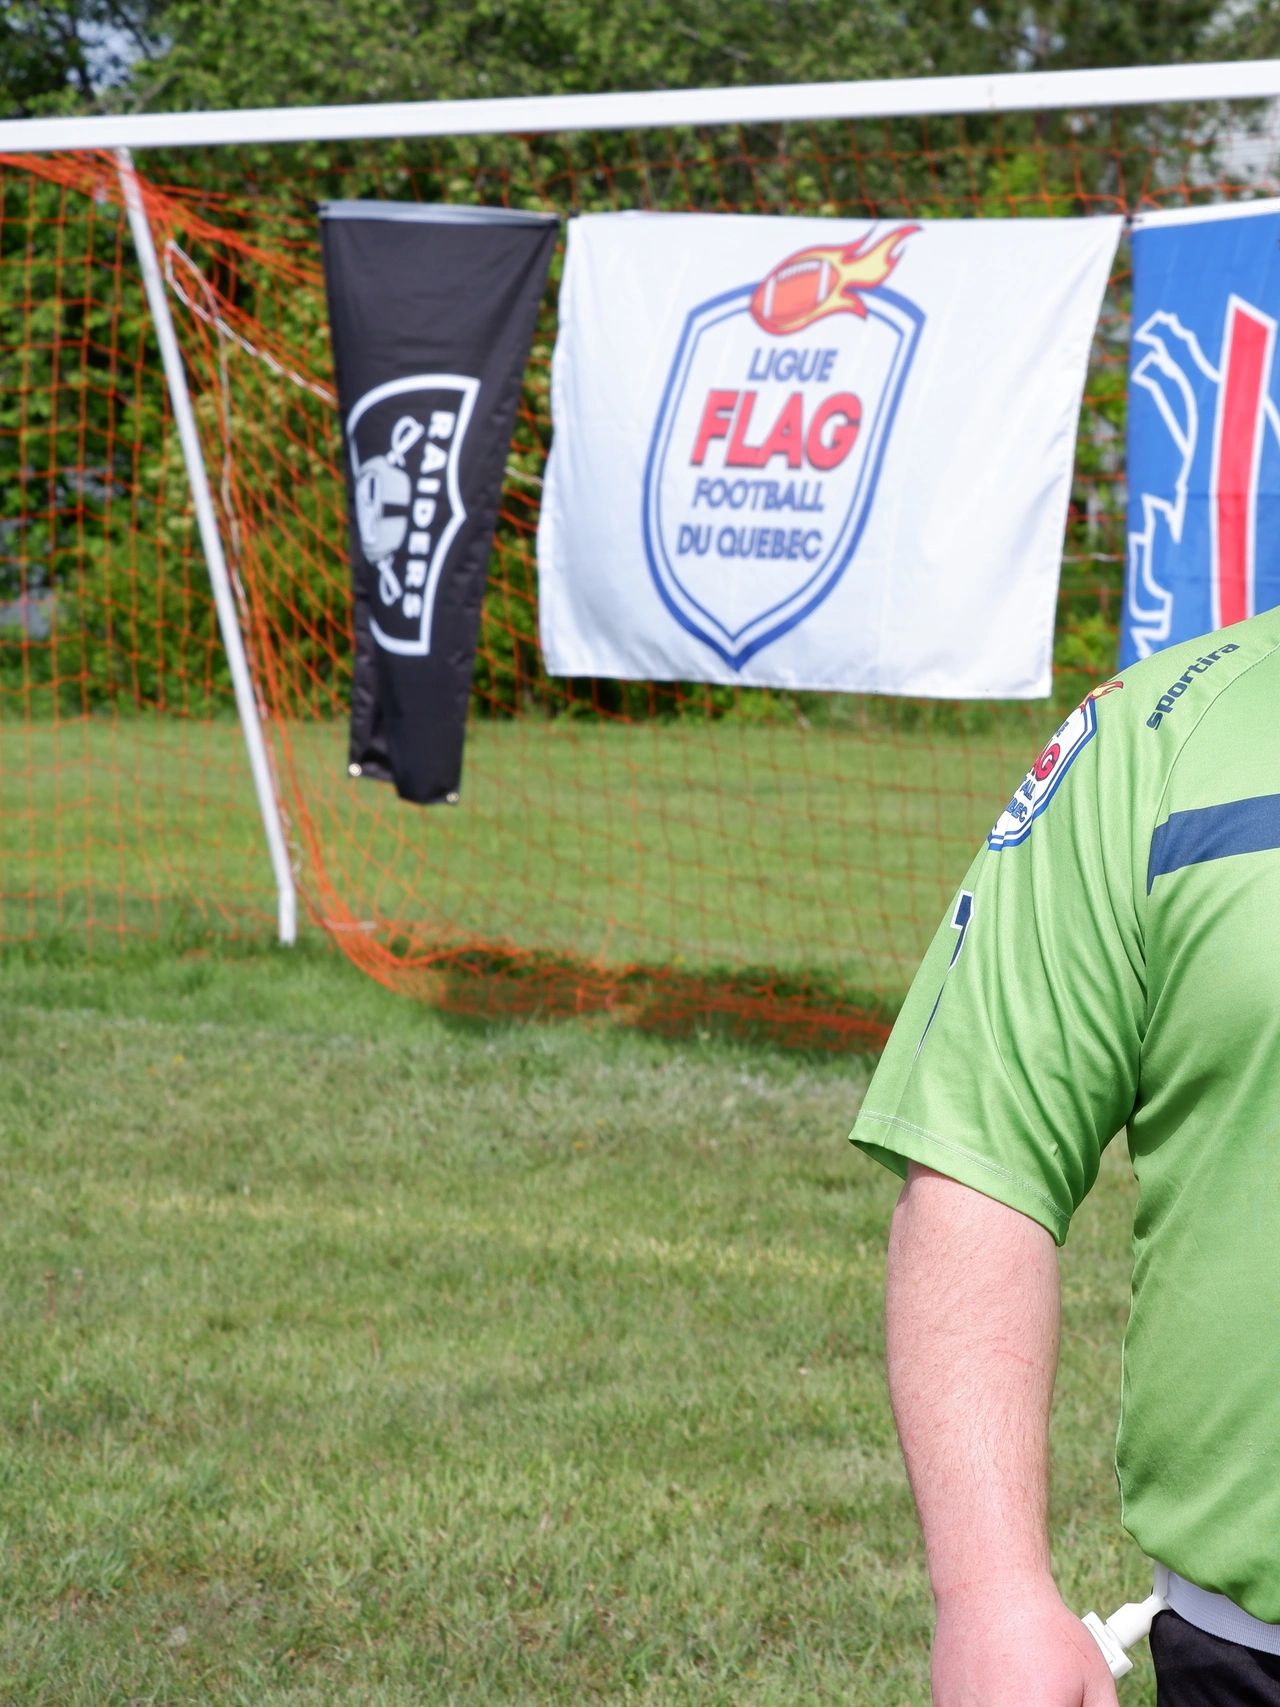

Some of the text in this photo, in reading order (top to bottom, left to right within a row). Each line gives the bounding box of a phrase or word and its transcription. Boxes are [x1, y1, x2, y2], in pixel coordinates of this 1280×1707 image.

[746, 347, 838, 382] LIGUE
[690, 388, 863, 470] FLAG
[402, 410, 456, 619] RAIDERS
[692, 478, 825, 513] FOOTBALL
[677, 526, 823, 562] DU QUEBEC
[1145, 643, 1241, 731] sportira
